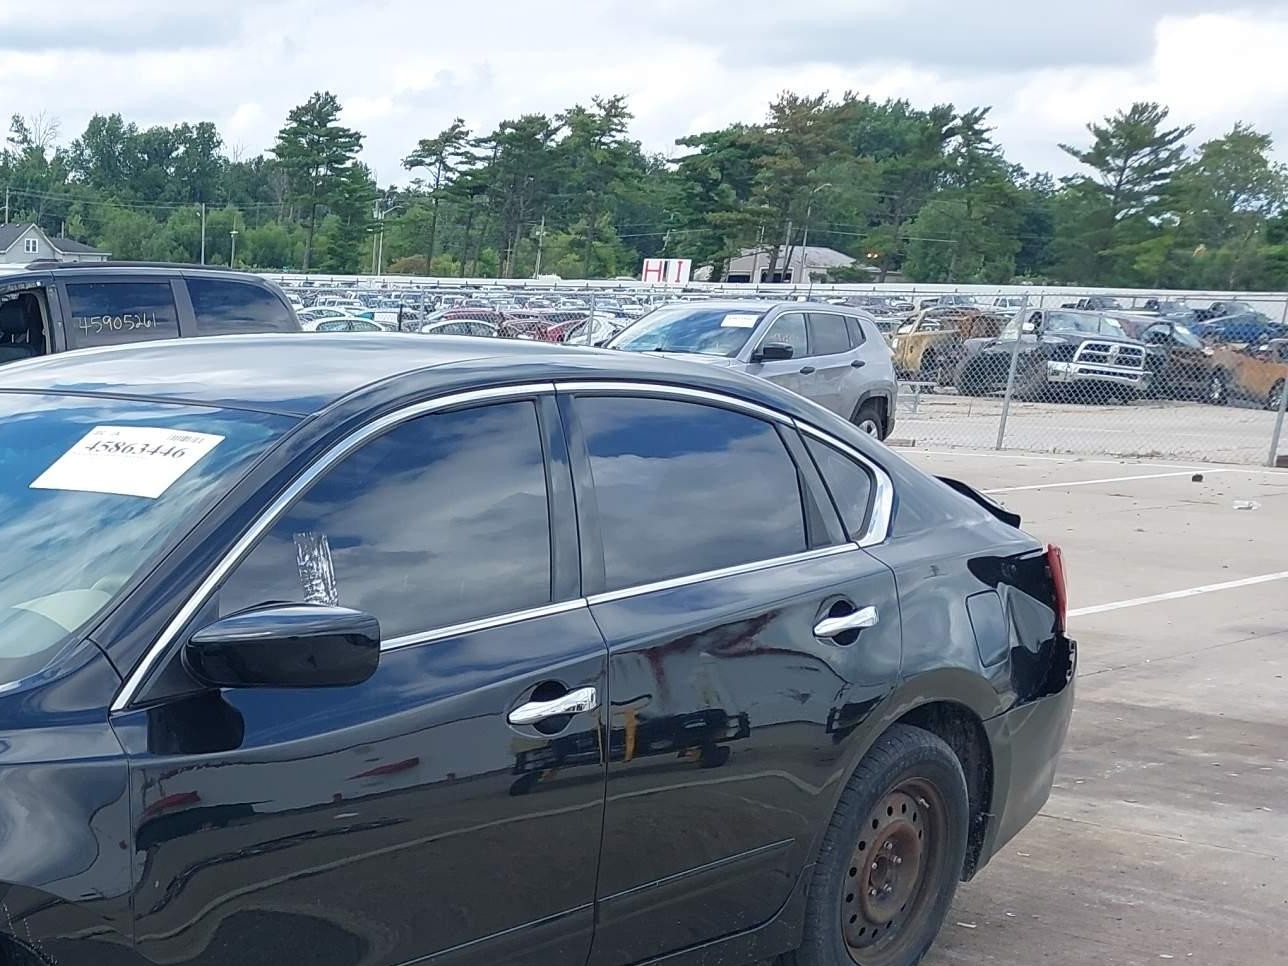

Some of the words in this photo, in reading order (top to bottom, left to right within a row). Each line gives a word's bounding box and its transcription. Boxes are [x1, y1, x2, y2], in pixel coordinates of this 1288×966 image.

[643, 260, 663, 282] H
[79, 311, 157, 337] 45905261
[85, 440, 189, 459] 45863446
